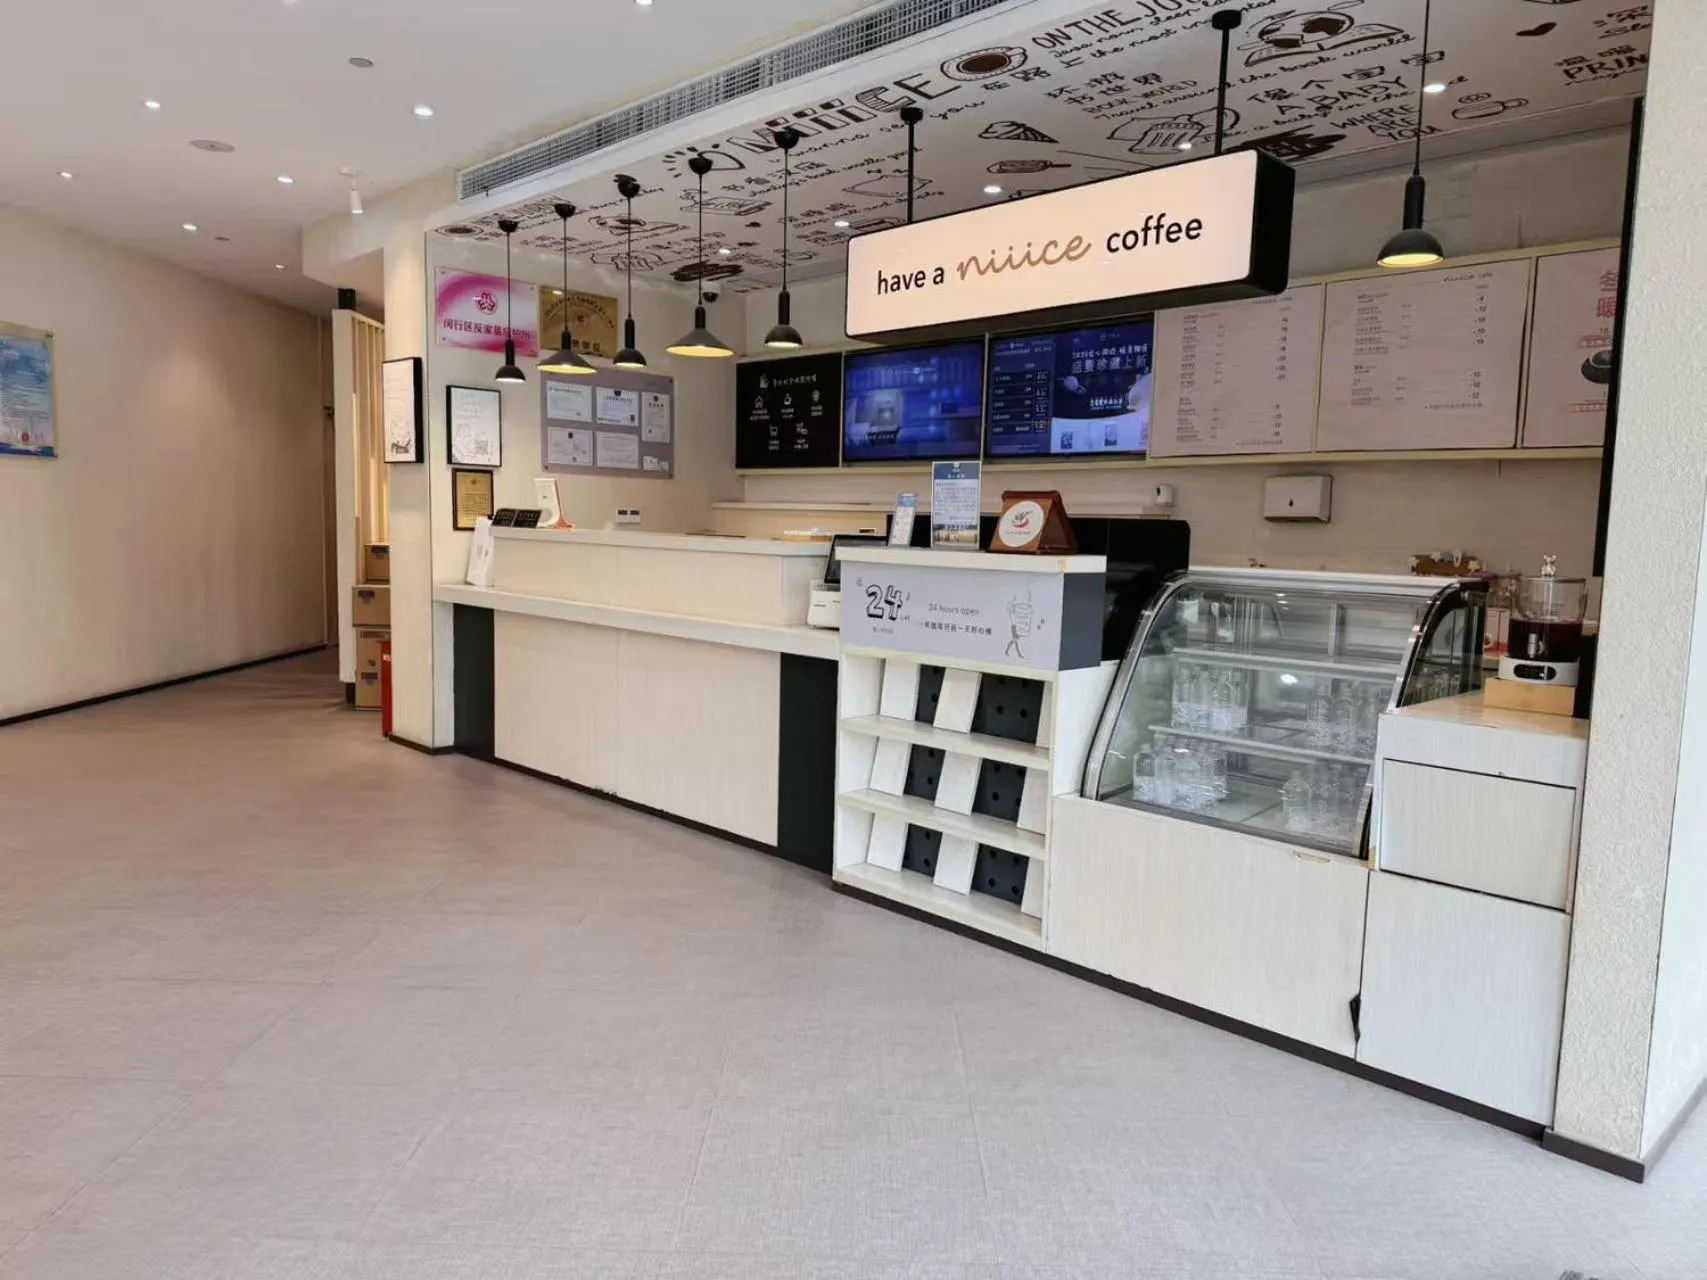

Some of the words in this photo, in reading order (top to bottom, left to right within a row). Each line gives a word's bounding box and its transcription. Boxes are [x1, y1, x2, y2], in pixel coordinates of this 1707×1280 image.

[1031, 27, 1073, 49] ON
[1064, 9, 1142, 36] THE
[1306, 75, 1408, 108] BABY
[1330, 103, 1418, 129] WHERE
[1367, 116, 1417, 134] ARE
[876, 269, 927, 295] have
[932, 265, 945, 285] a
[956, 232, 1093, 281] niiice
[1105, 212, 1203, 254] coffee
[866, 584, 904, 621] 24
[927, 602, 938, 613] 24
[939, 604, 960, 616] hours
[961, 606, 981, 617] open
